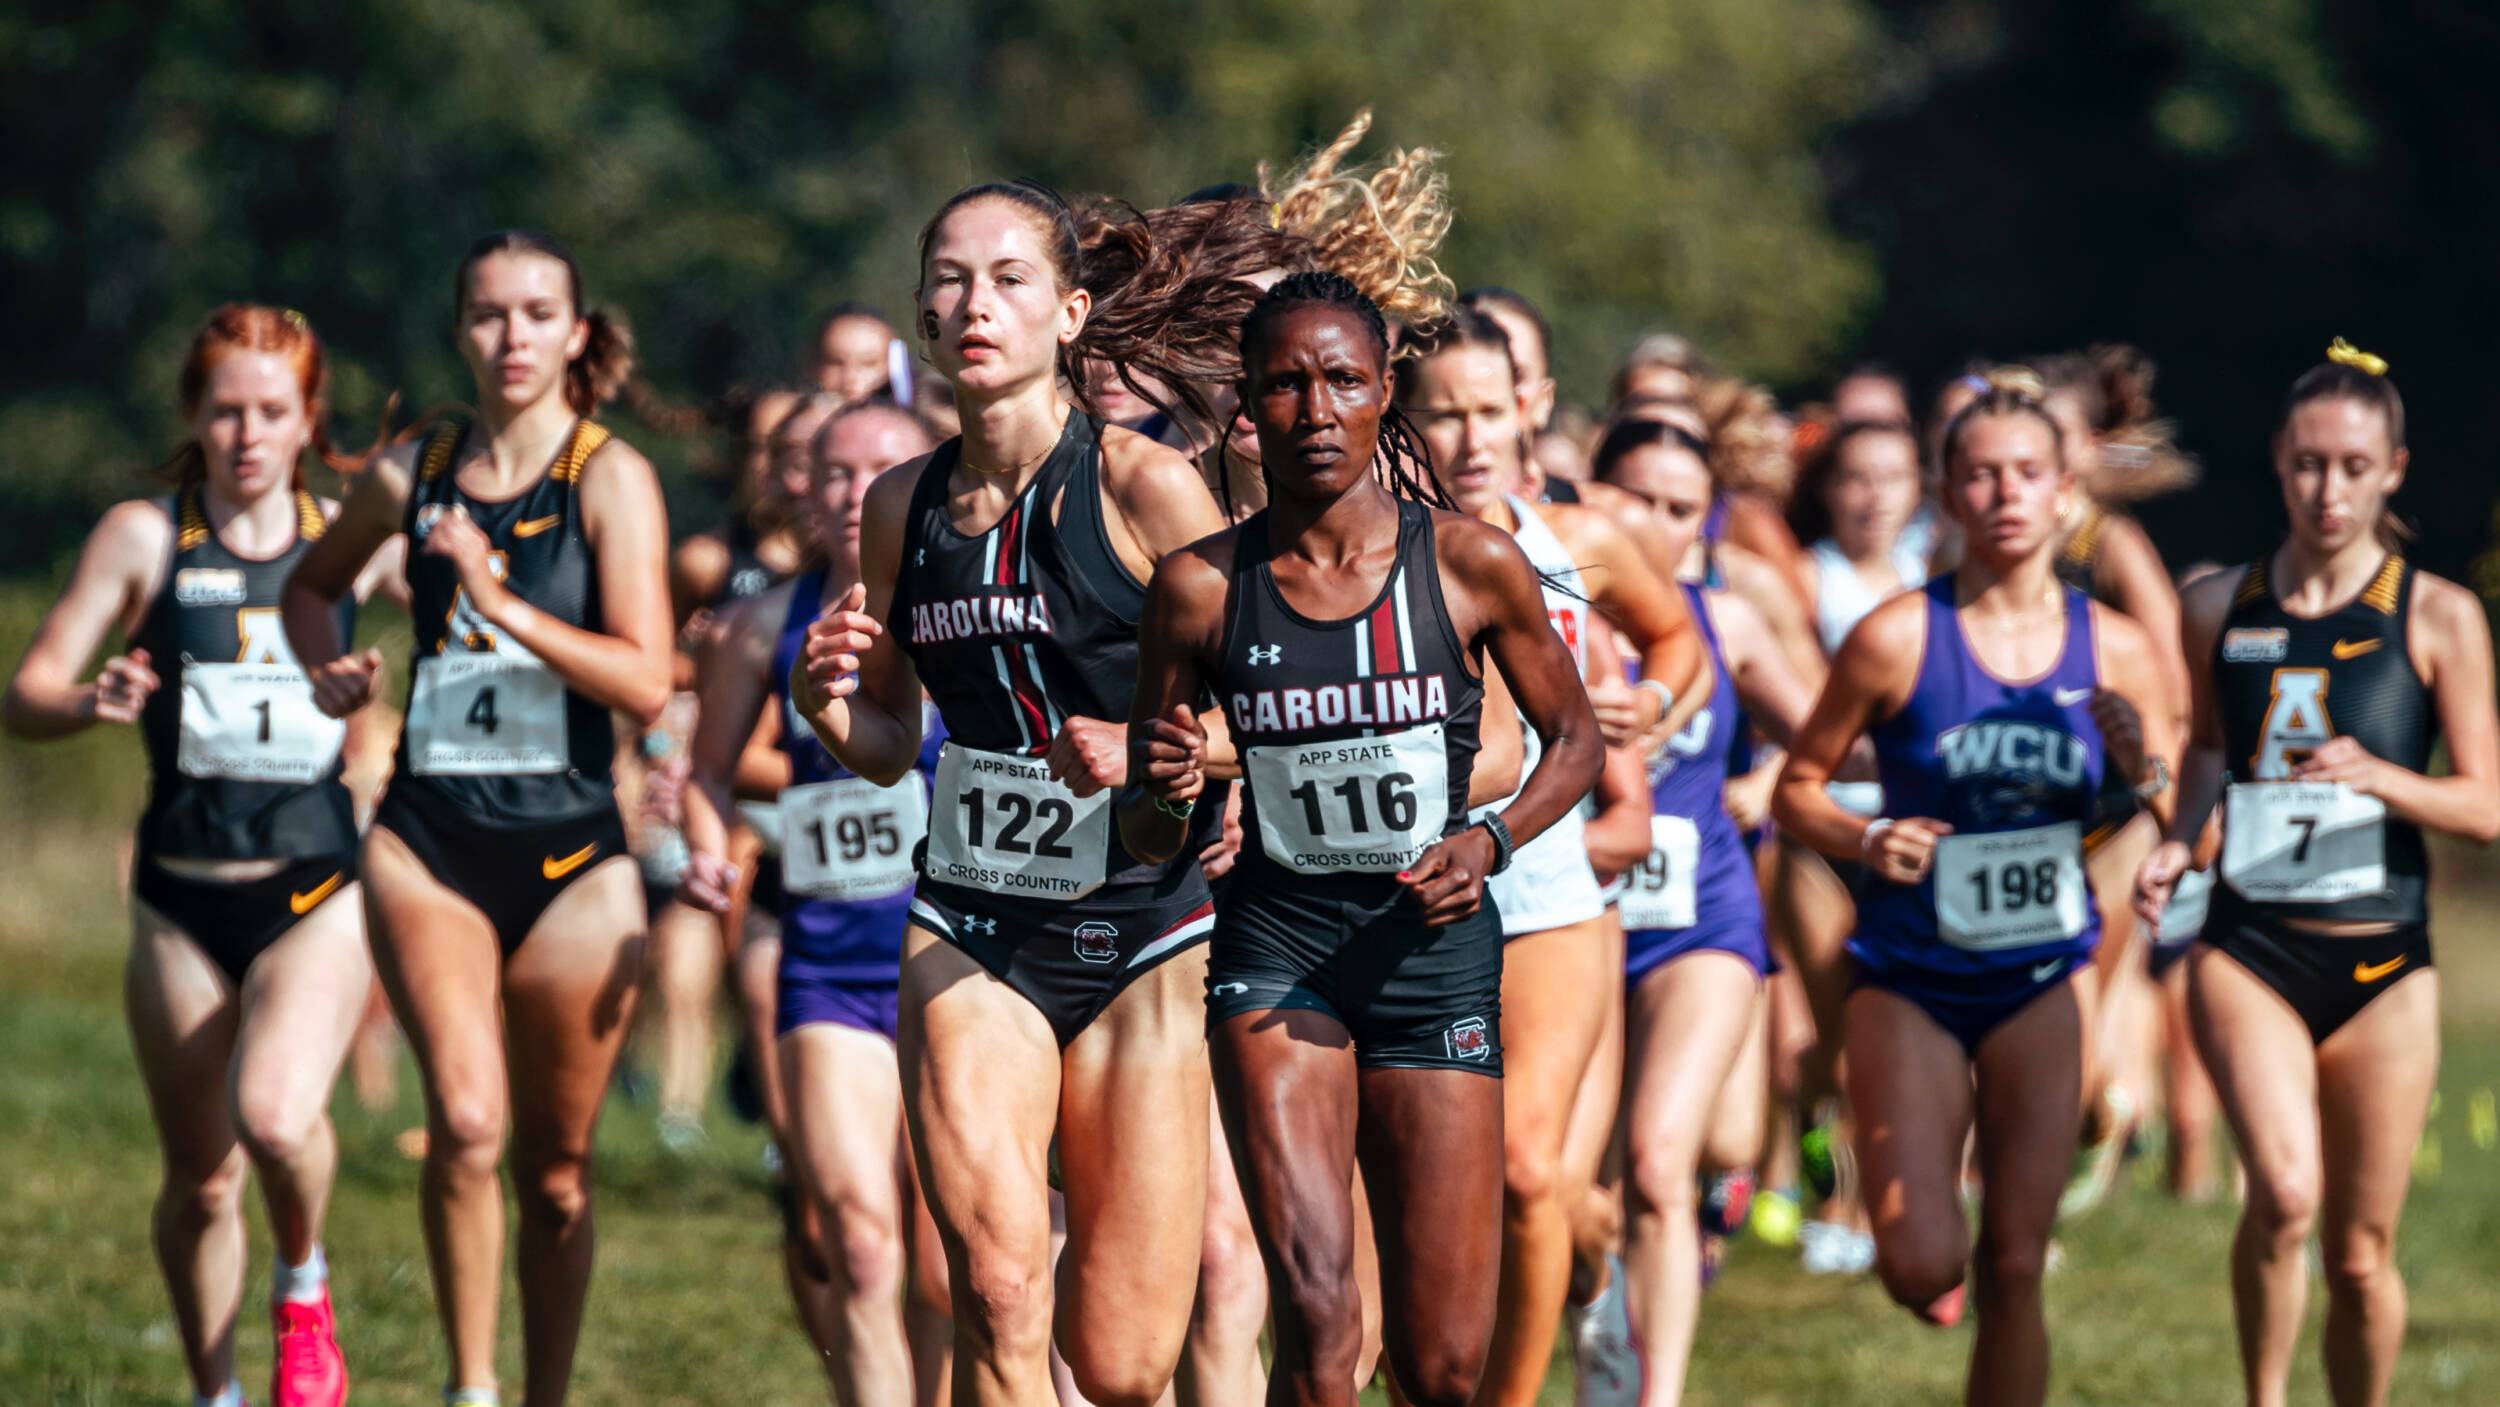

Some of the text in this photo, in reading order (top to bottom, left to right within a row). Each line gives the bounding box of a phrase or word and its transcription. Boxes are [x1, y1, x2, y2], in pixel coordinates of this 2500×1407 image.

[252, 699, 270, 744] 1
[465, 686, 498, 736] 4
[1232, 674, 1448, 732] CAROLINA
[2249, 667, 2346, 781] A
[972, 758, 1049, 781] APP STAT
[1299, 744, 1393, 766] APP STATE
[1936, 720, 2089, 787] WCU
[959, 787, 1073, 859] 122
[1290, 772, 1417, 836] 116
[804, 810, 901, 867] 195
[1294, 849, 1414, 867] CROSS COUNT
[2288, 815, 2318, 862] 7
[948, 863, 1081, 893] CROSS COUNTRY
[1967, 855, 2059, 914] 198
